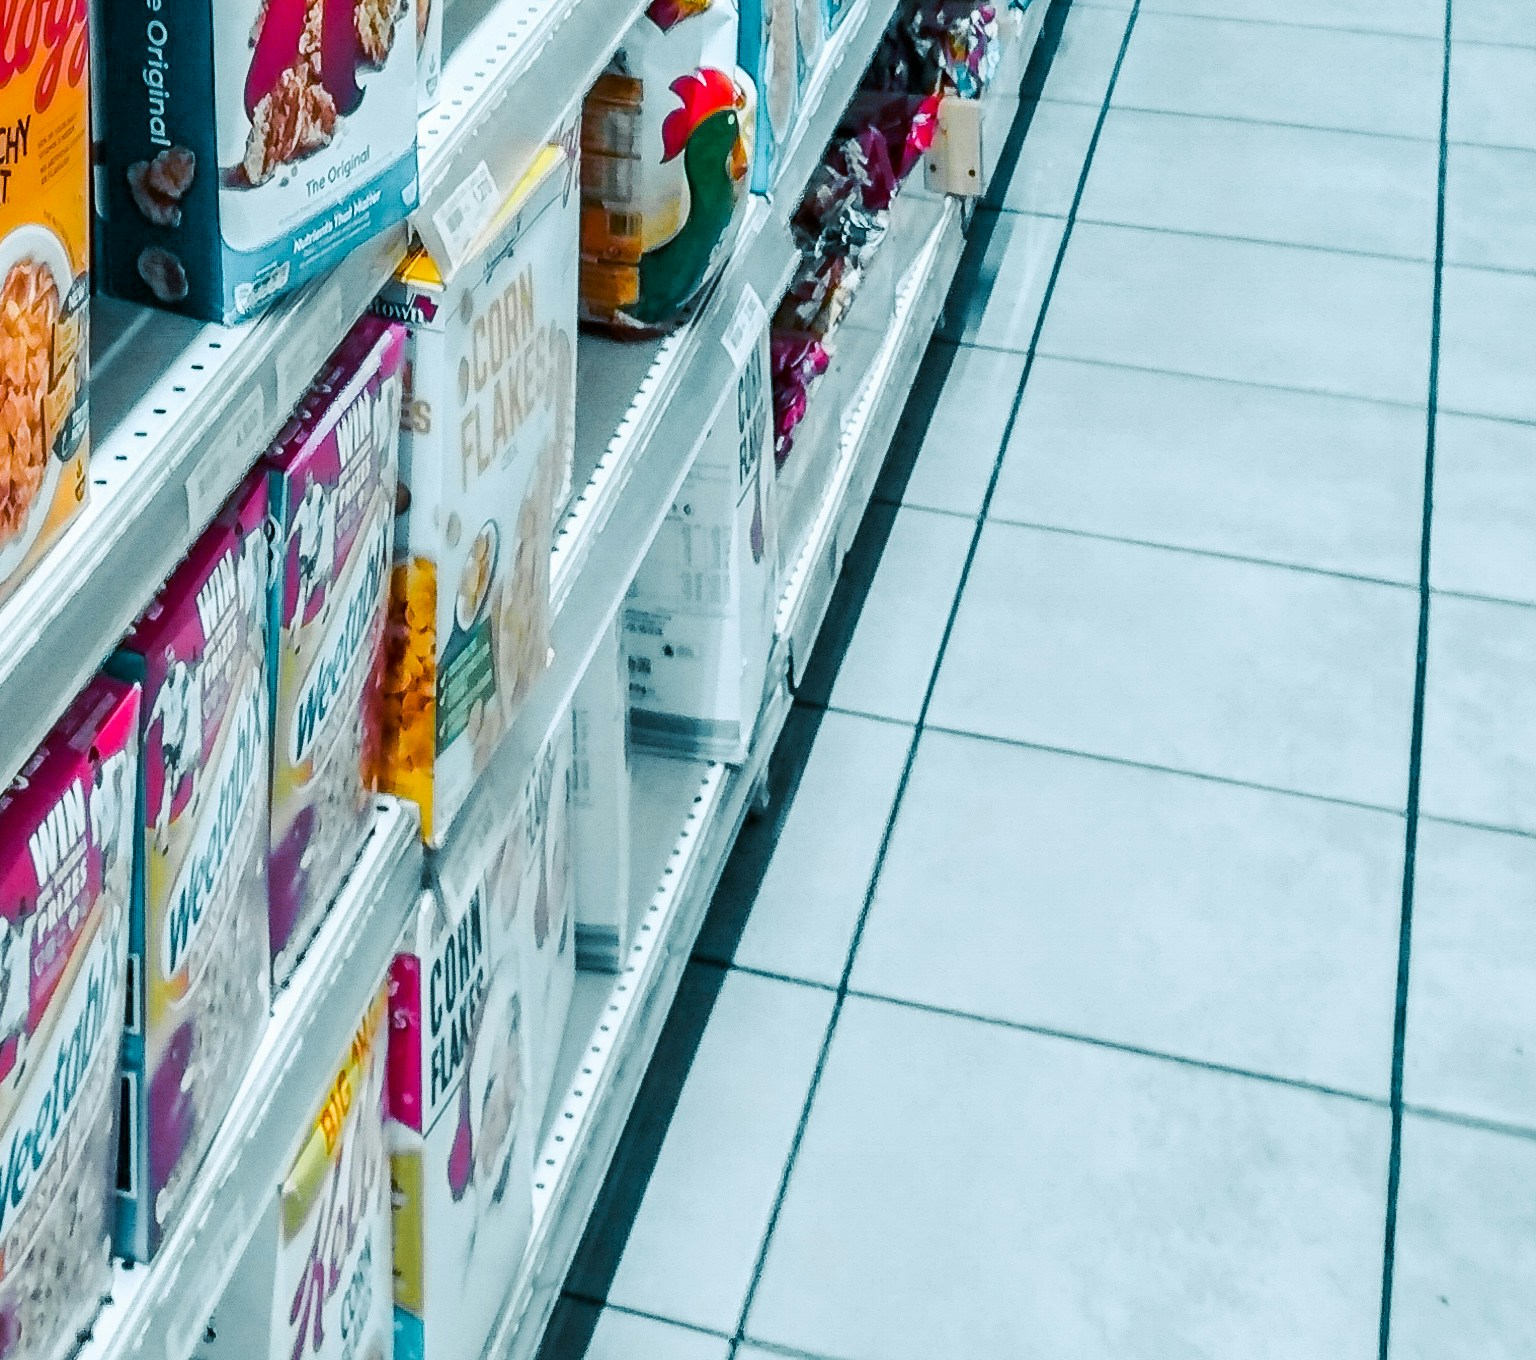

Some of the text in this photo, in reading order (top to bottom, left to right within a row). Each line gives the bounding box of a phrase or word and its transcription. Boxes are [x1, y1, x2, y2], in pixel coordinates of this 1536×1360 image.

[143, 13, 172, 147] Original
[292, 186, 384, 256] Nutrients Matter
[305, 144, 372, 199] The Original
[467, 260, 537, 378] CORN
[460, 316, 562, 482] FLAKES
[195, 547, 238, 641] WIN
[27, 775, 88, 889] WIN
